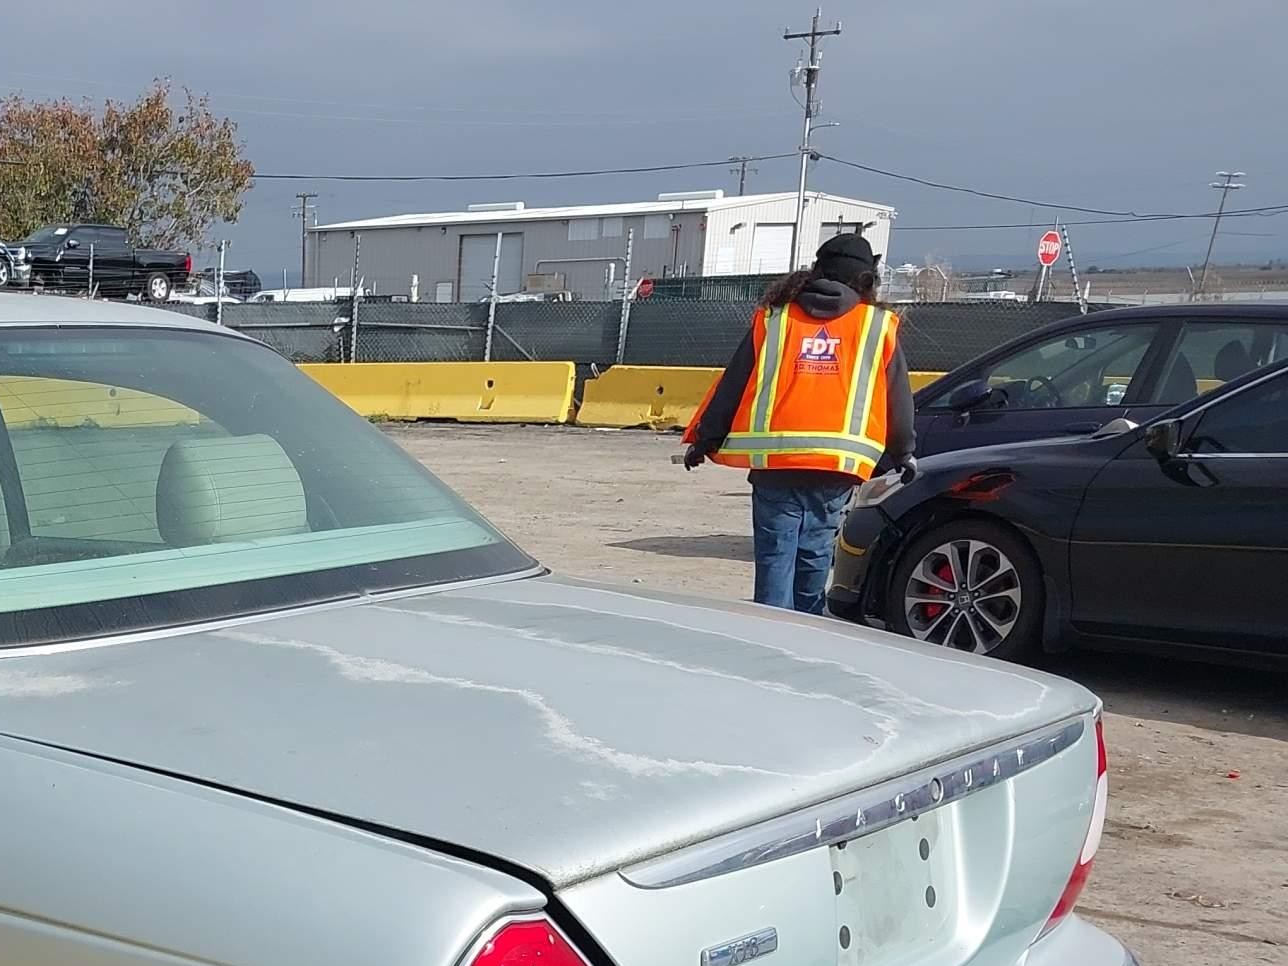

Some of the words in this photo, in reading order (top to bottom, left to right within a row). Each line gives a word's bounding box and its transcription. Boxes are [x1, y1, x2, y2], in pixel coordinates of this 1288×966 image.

[1040, 241, 1059, 254] STOP
[801, 337, 841, 355] FDT
[808, 364, 840, 372] THOMAS
